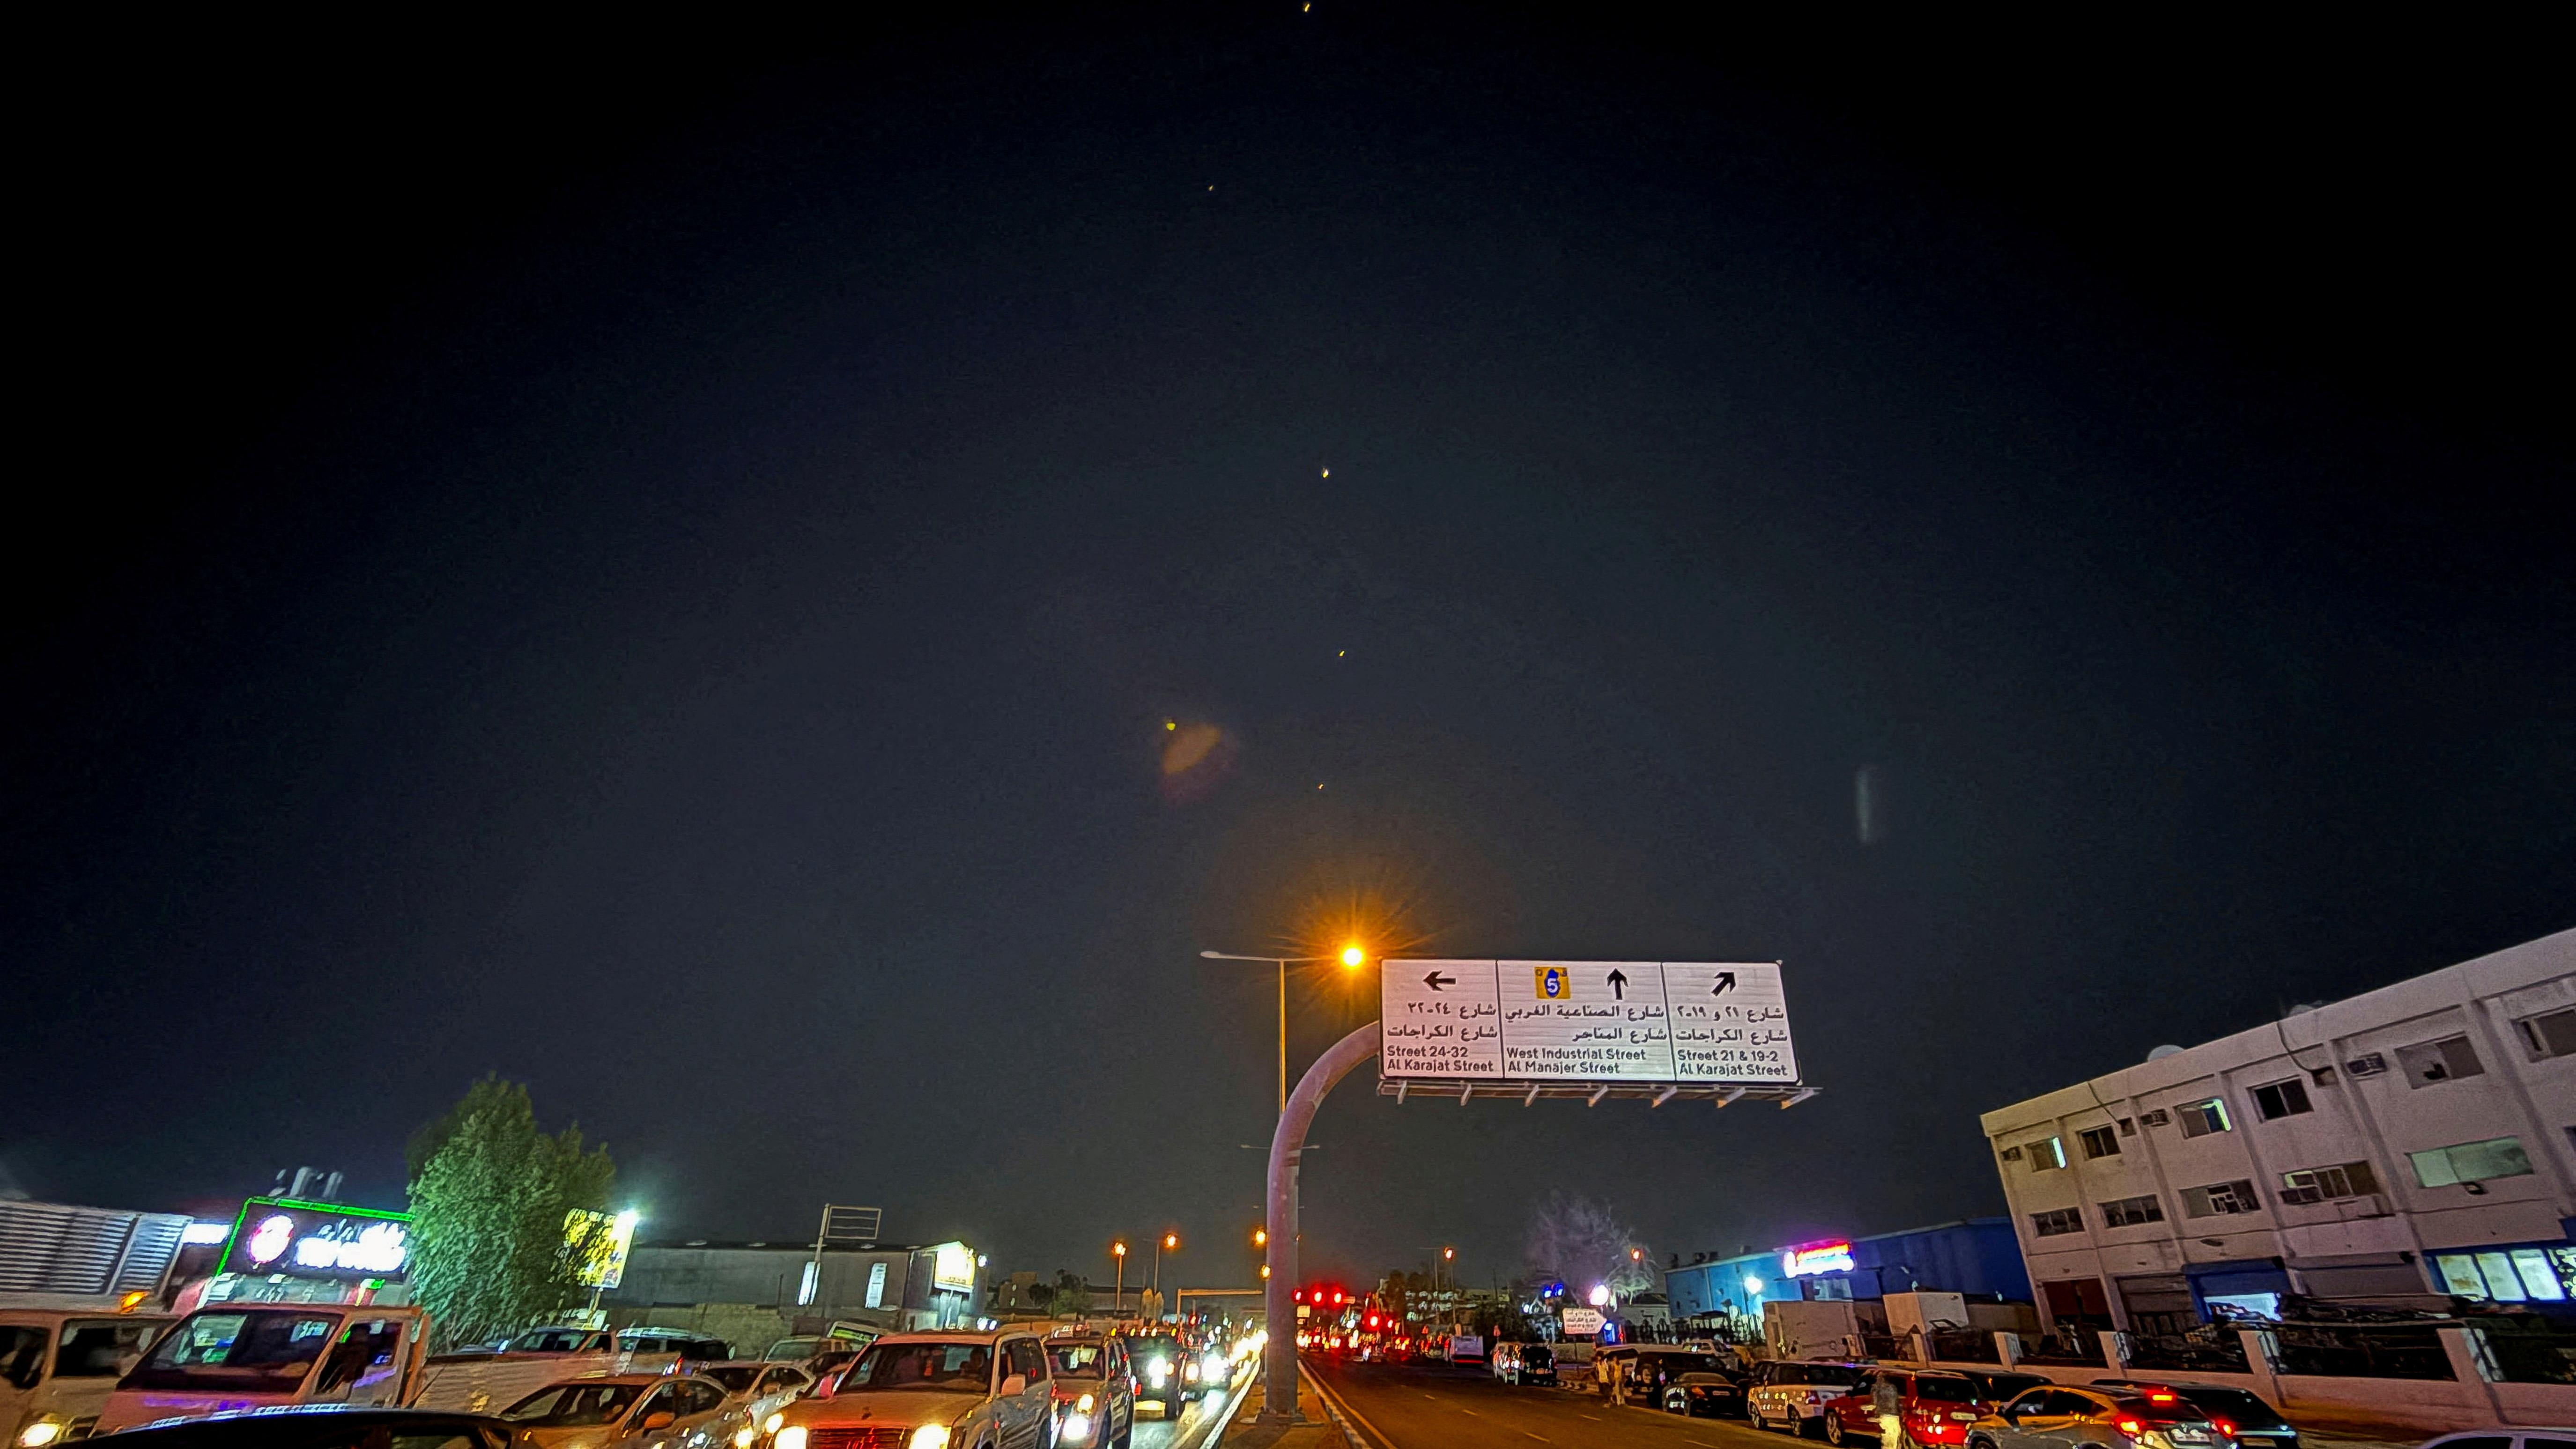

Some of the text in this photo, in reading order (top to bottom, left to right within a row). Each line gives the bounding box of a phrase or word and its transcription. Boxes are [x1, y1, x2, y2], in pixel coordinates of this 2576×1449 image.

[1547, 977, 1558, 993] 5
[1459, 1003, 1496, 1020] شارع
[1556, 1004, 1620, 1020] الصناعية
[1627, 1005, 1664, 1023] شارع
[1712, 1011, 1721, 1021] و
[1725, 1005, 1739, 1018] ٢١
[1747, 1006, 1784, 1023] شارع
[1387, 1024, 1498, 1042] شارع الكراجات
[1630, 1027, 1667, 1044] شارع
[1675, 1028, 1788, 1046] شارع الكراجات
[1387, 1044, 1469, 1058] Street 24-32
[1506, 1046, 1647, 1060] West Industrial Street
[1677, 1049, 1779, 1062] Street 21 & 19-2
[1387, 1058, 1495, 1073] Al Karajat Street
[1508, 1060, 1621, 1075] Al Manajer Street
[1679, 1062, 1788, 1077] Al Karajat Street
